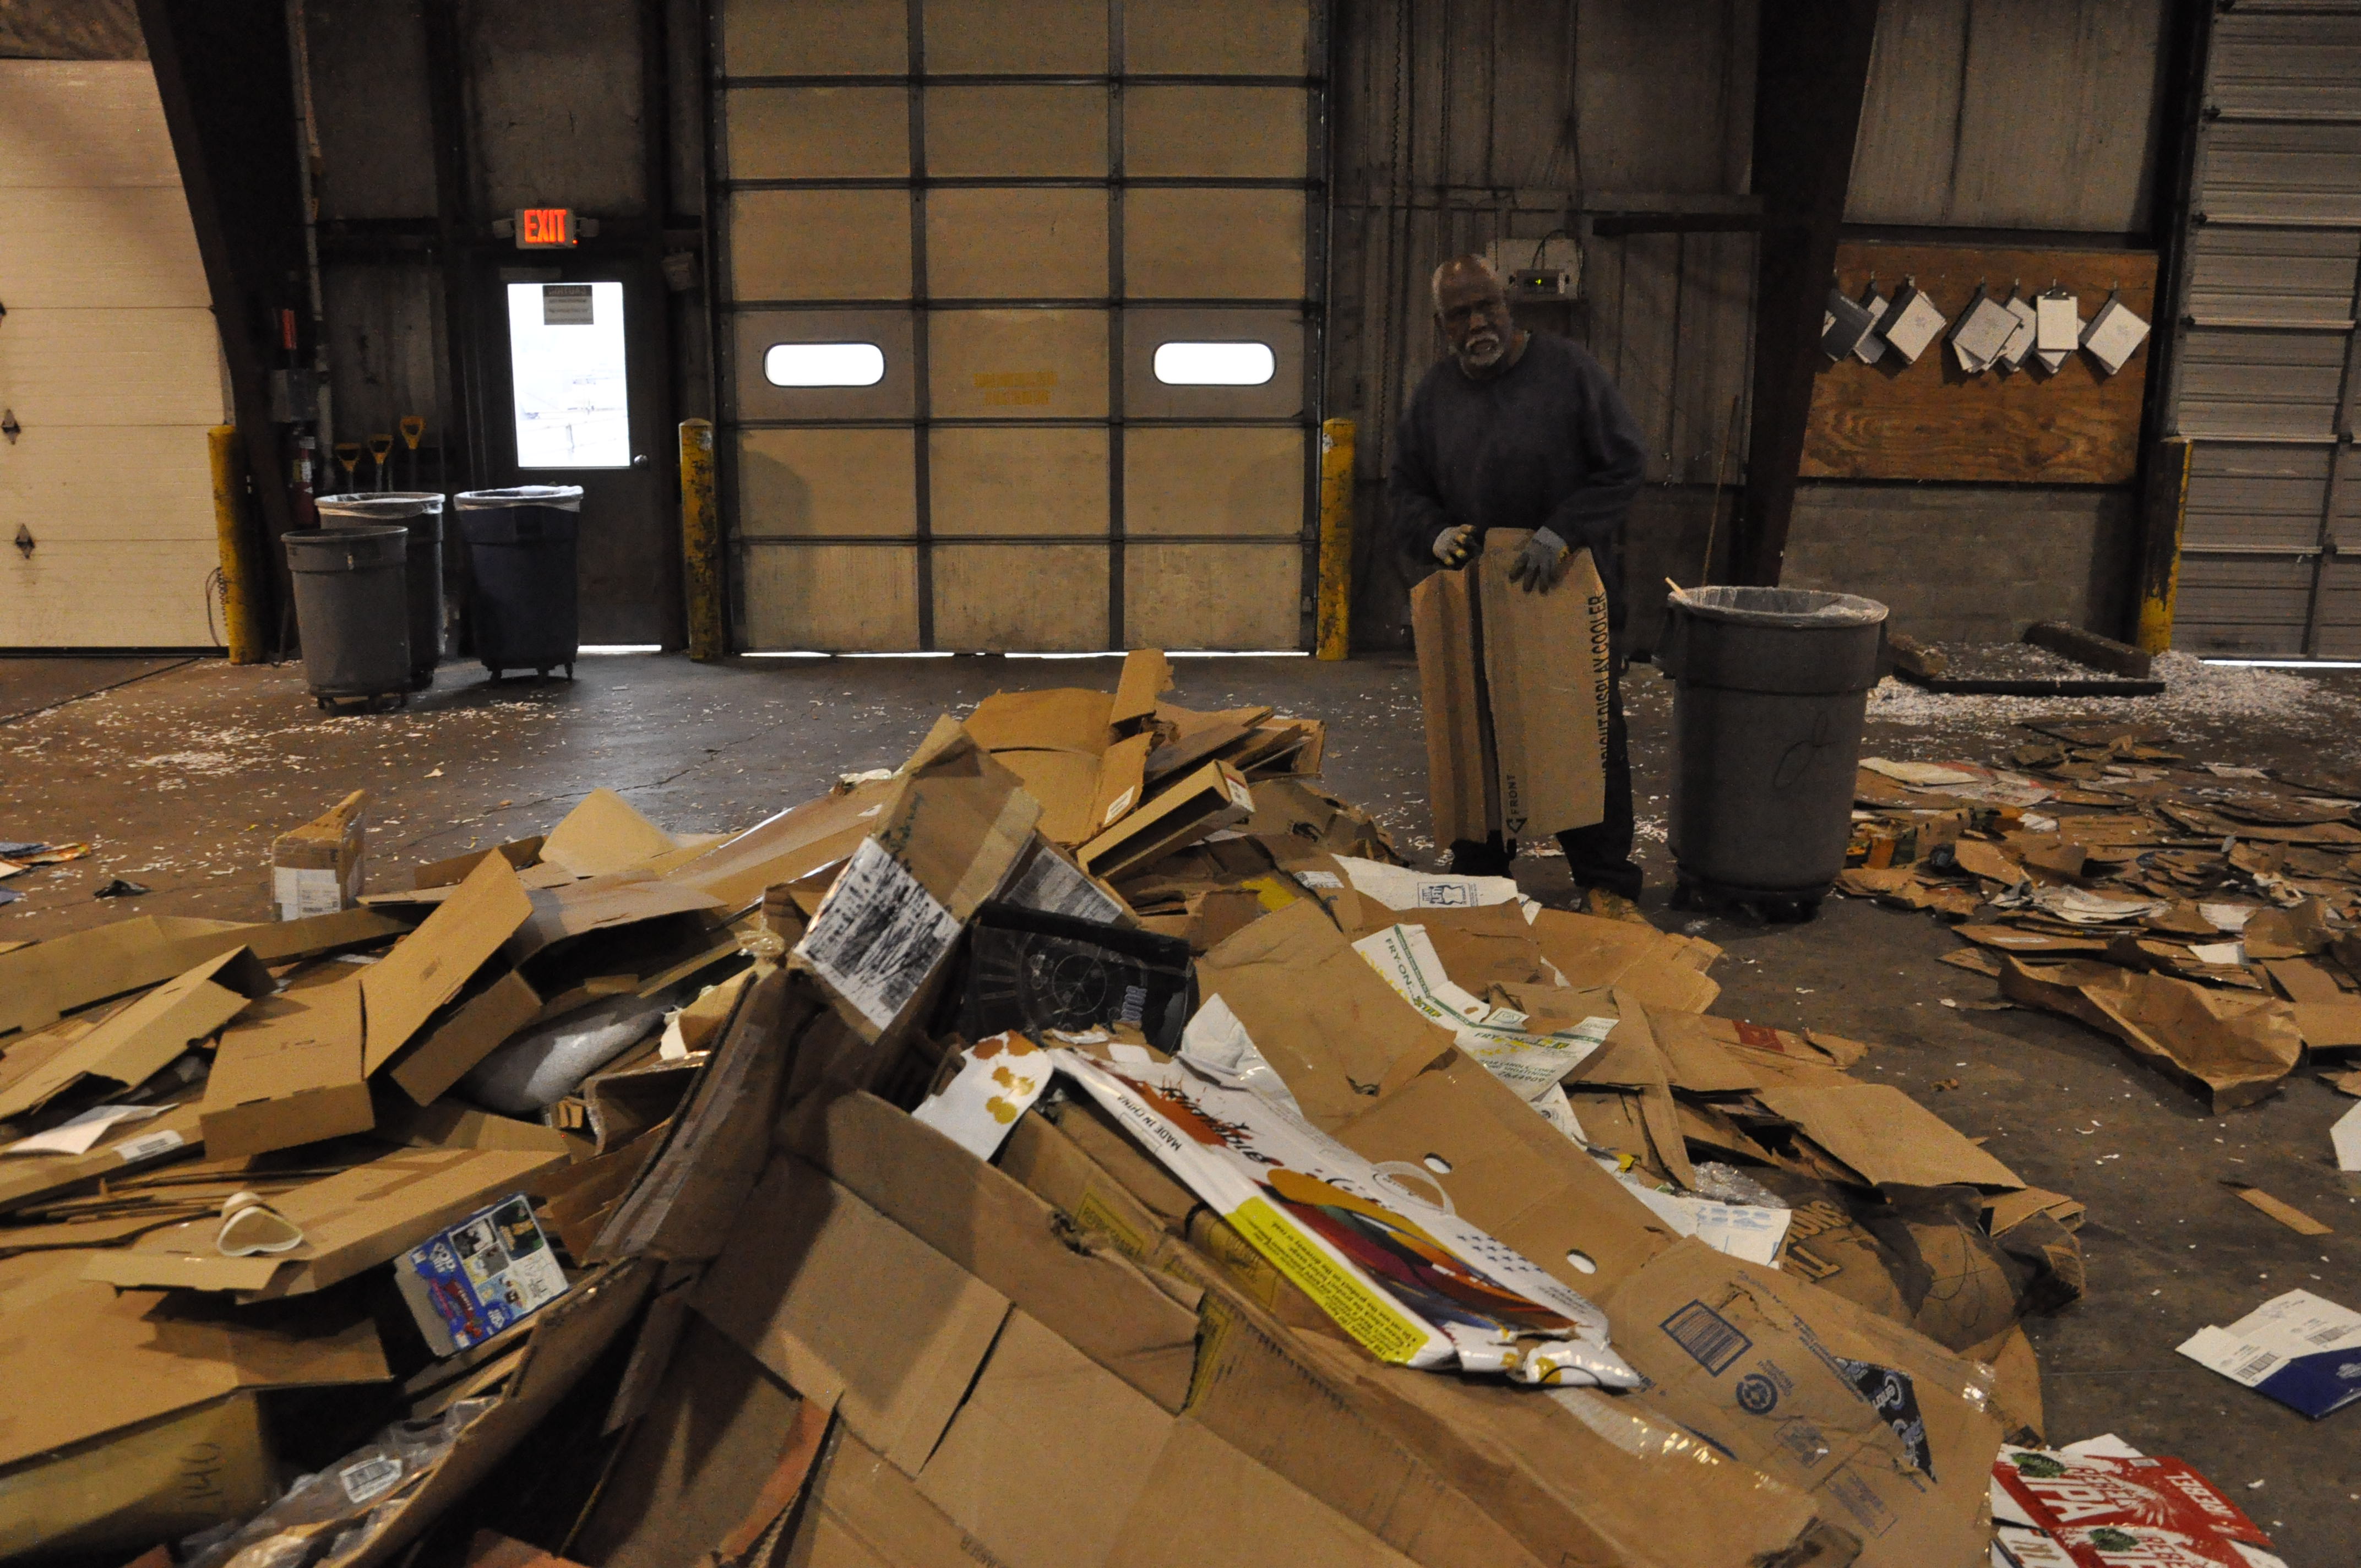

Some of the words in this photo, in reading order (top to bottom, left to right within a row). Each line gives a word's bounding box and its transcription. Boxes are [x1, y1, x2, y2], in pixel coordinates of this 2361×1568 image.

[524, 208, 567, 243] EXIT
[1588, 591, 1609, 654] COOLER
[1506, 775, 1519, 814] FRONT
[1116, 1093, 1146, 1119] CHINA
[1142, 1115, 1156, 1128] IN
[1151, 1124, 1184, 1152] MADE
[2019, 1476, 2123, 1523] IPA
[2165, 1471, 2238, 1519] REBEL
